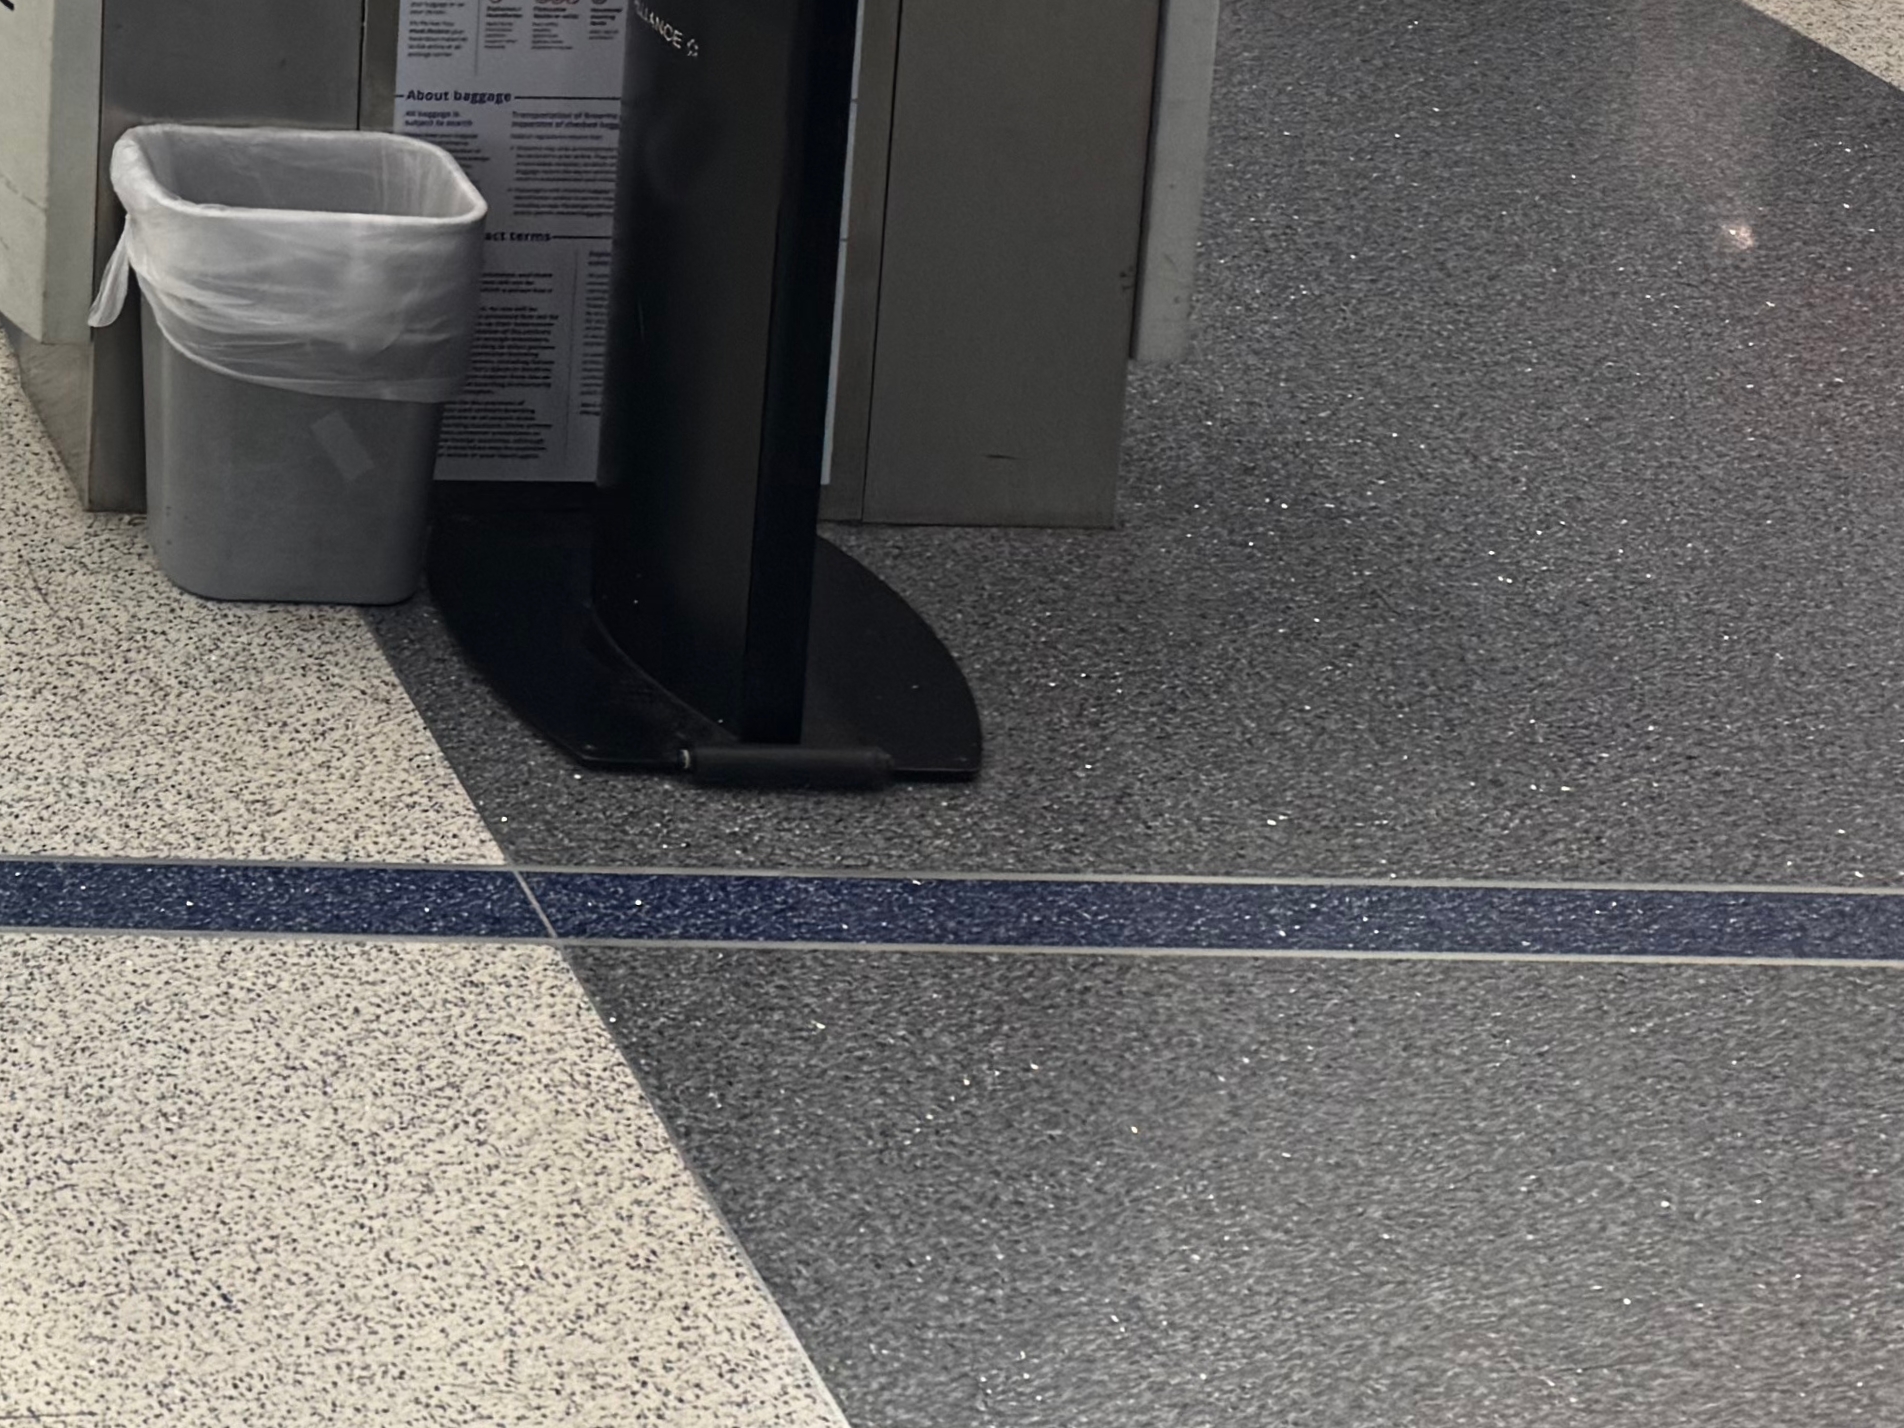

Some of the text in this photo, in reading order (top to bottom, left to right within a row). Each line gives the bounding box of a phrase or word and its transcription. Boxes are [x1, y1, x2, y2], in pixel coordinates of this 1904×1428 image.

[405, 89, 512, 104] About baggage
[510, 231, 552, 241] terms
